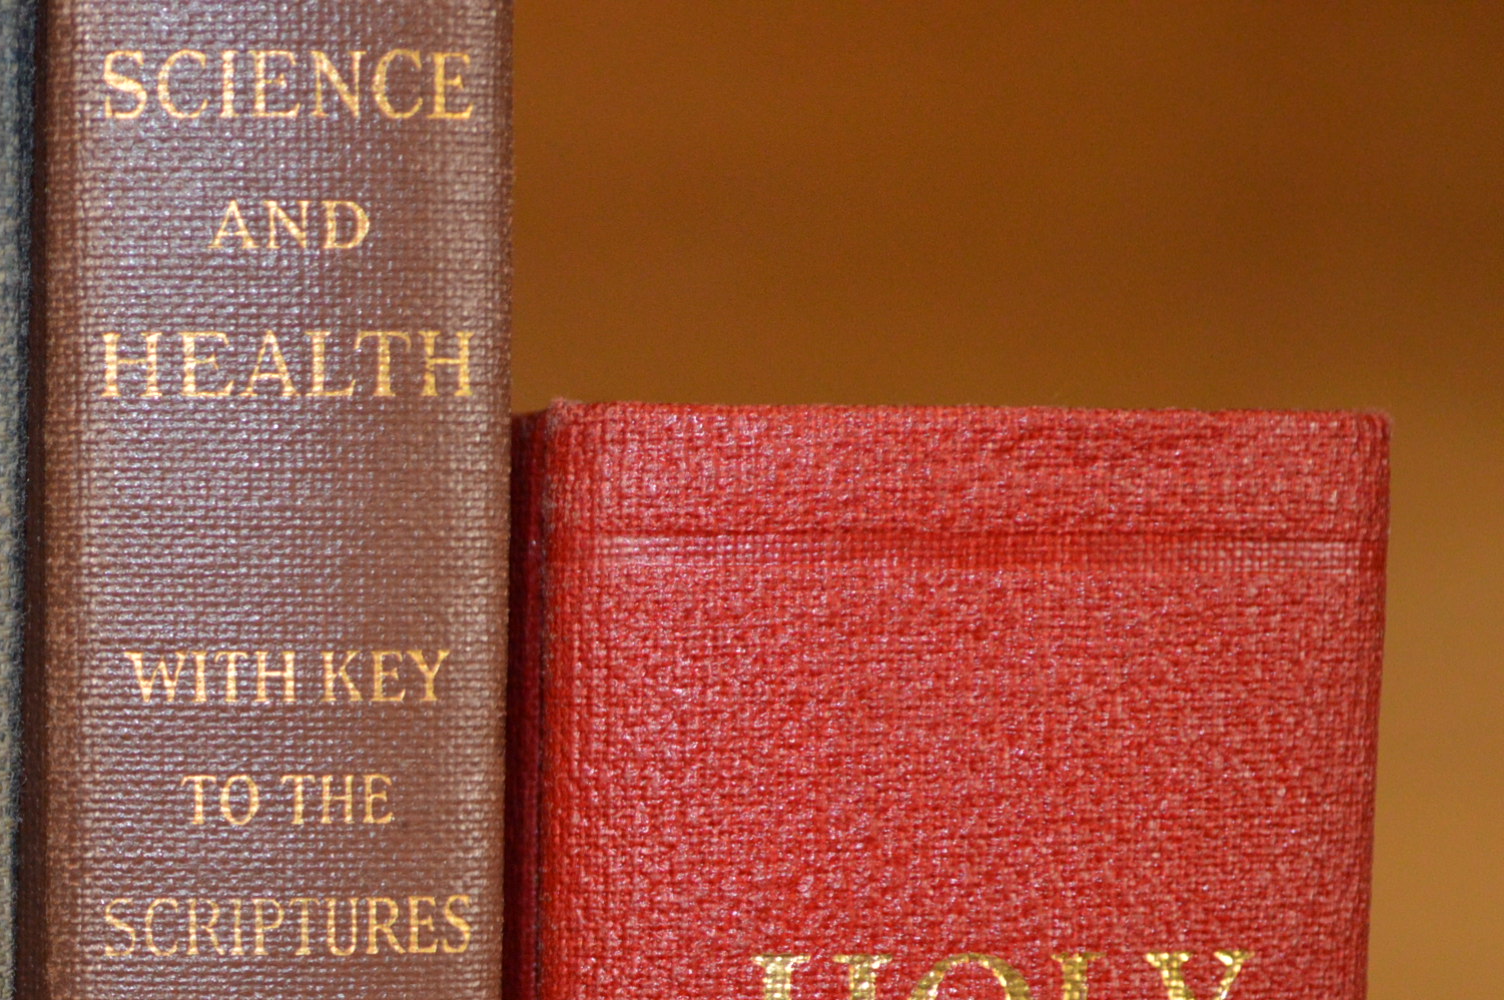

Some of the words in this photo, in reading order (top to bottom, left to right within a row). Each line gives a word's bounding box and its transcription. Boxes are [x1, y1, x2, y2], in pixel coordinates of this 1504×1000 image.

[101, 48, 474, 120] SCIENCE
[208, 200, 371, 250] AND
[100, 329, 475, 398] HEALTH
[123, 650, 297, 703] WITH
[320, 649, 451, 702] KEY
[180, 773, 261, 826] TO
[281, 772, 394, 825] THE
[103, 894, 472, 957] SCRIPTURES
